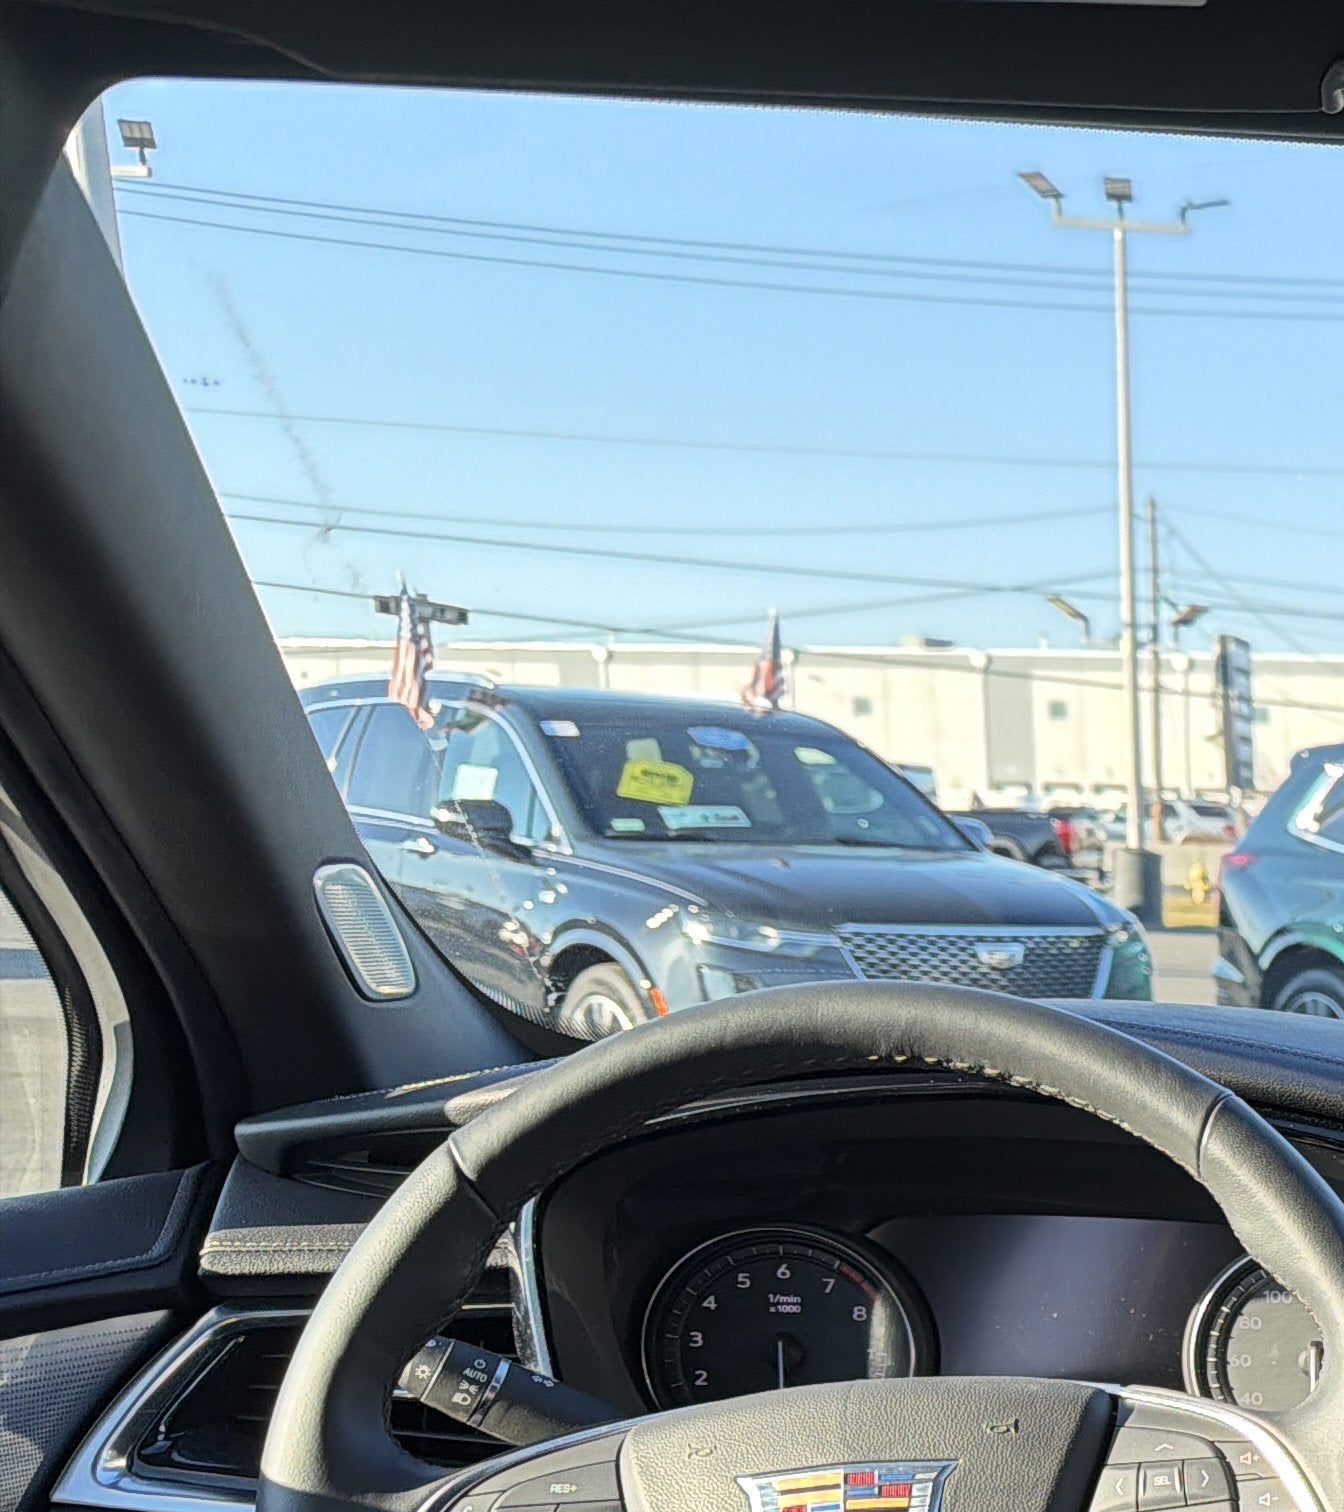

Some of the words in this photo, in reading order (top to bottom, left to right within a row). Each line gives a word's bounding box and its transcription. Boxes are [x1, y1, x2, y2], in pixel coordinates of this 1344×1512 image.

[776, 1263, 791, 1279] 6
[736, 1272, 751, 1289] 5
[821, 1278, 836, 1294] 7
[701, 1294, 717, 1310] 4
[767, 1293, 802, 1304] 1/min
[1262, 1290, 1293, 1305] 100
[852, 1305, 867, 1322] 8
[1239, 1315, 1262, 1331] 80
[688, 1331, 703, 1348] 3
[1230, 1353, 1252, 1368] 60
[462, 1367, 488, 1383] AUTO
[693, 1370, 709, 1386] 2
[1239, 1391, 1264, 1406] 40
[550, 1482, 579, 1495] RES+
[1153, 1474, 1172, 1487] SEL
